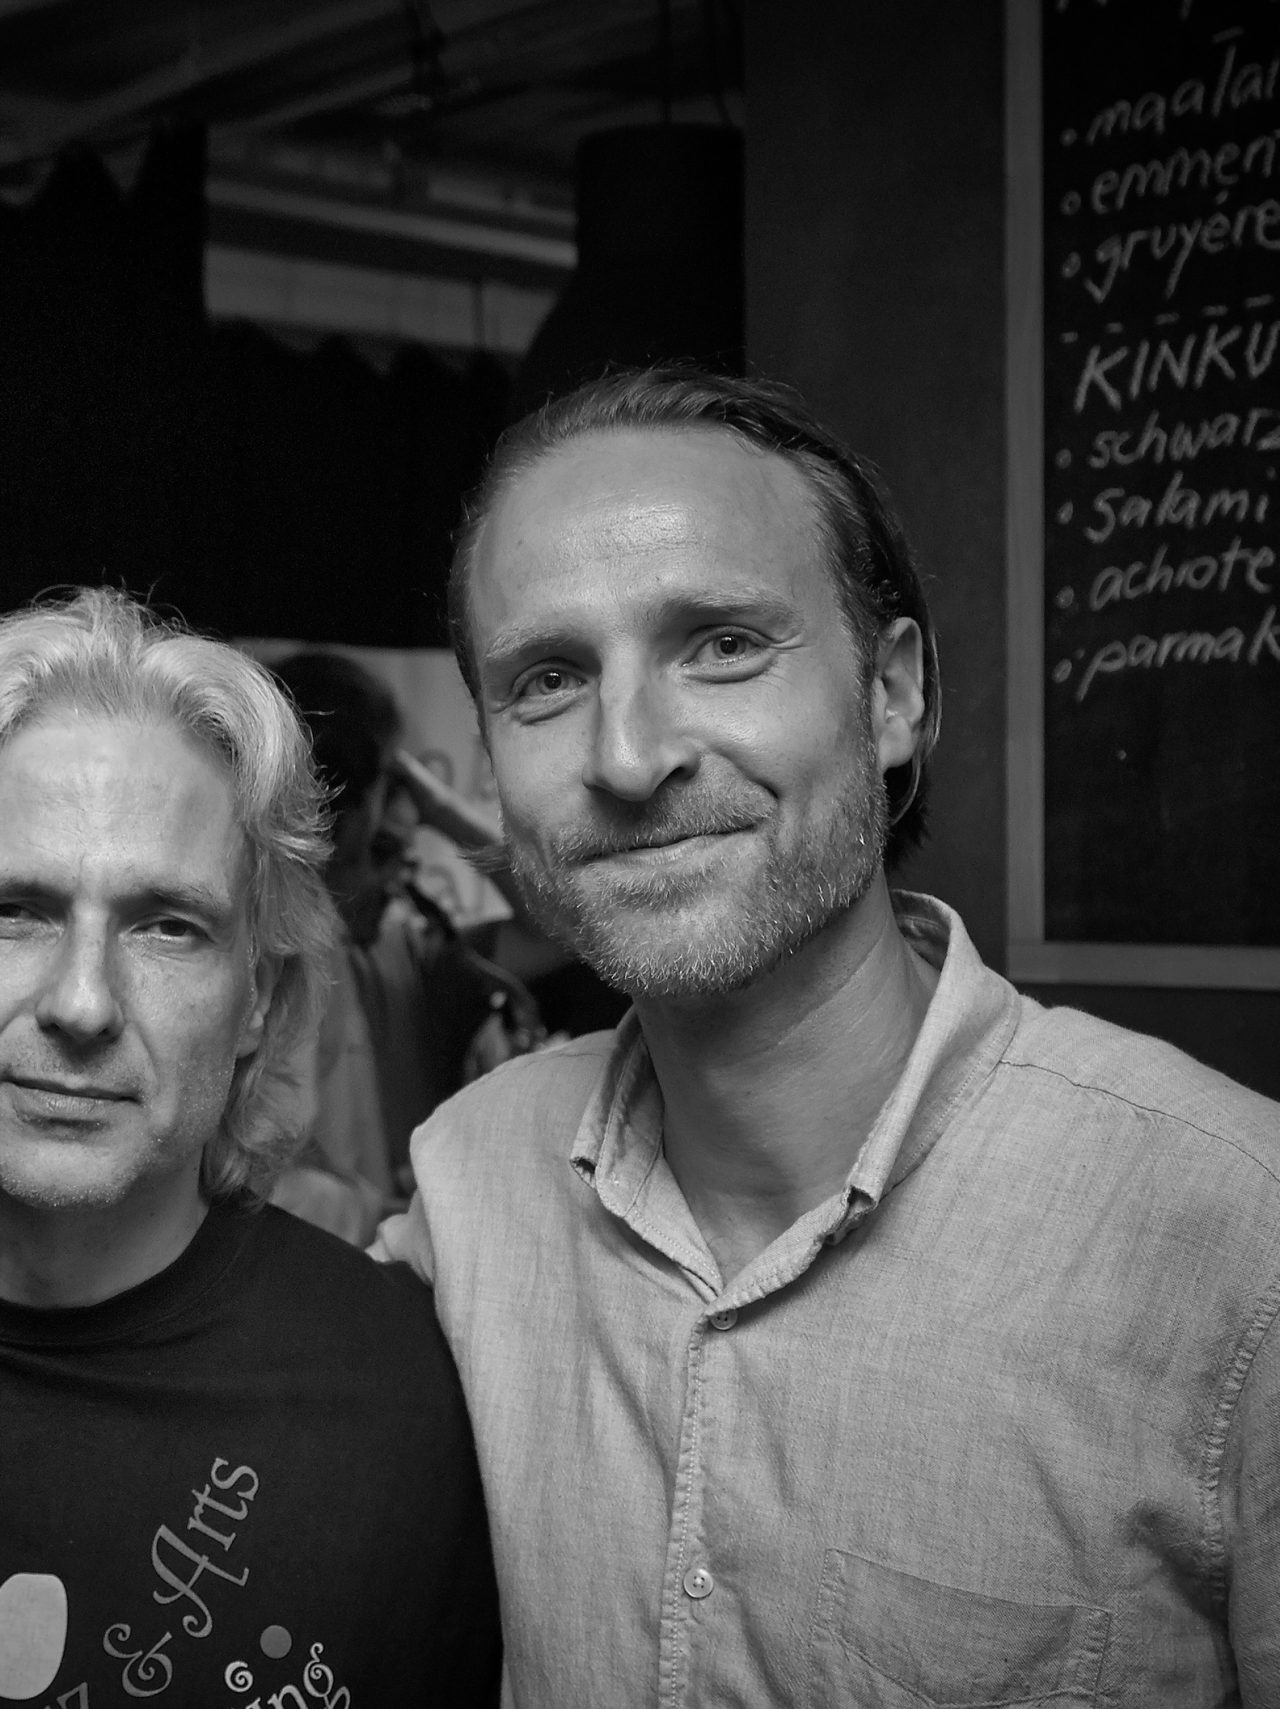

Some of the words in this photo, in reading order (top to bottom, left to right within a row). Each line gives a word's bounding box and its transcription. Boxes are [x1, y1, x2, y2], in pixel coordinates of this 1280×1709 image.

[1091, 130, 1280, 215] emmen
[102, 1622, 173, 1698] &
[151, 1456, 260, 1639] Arts
